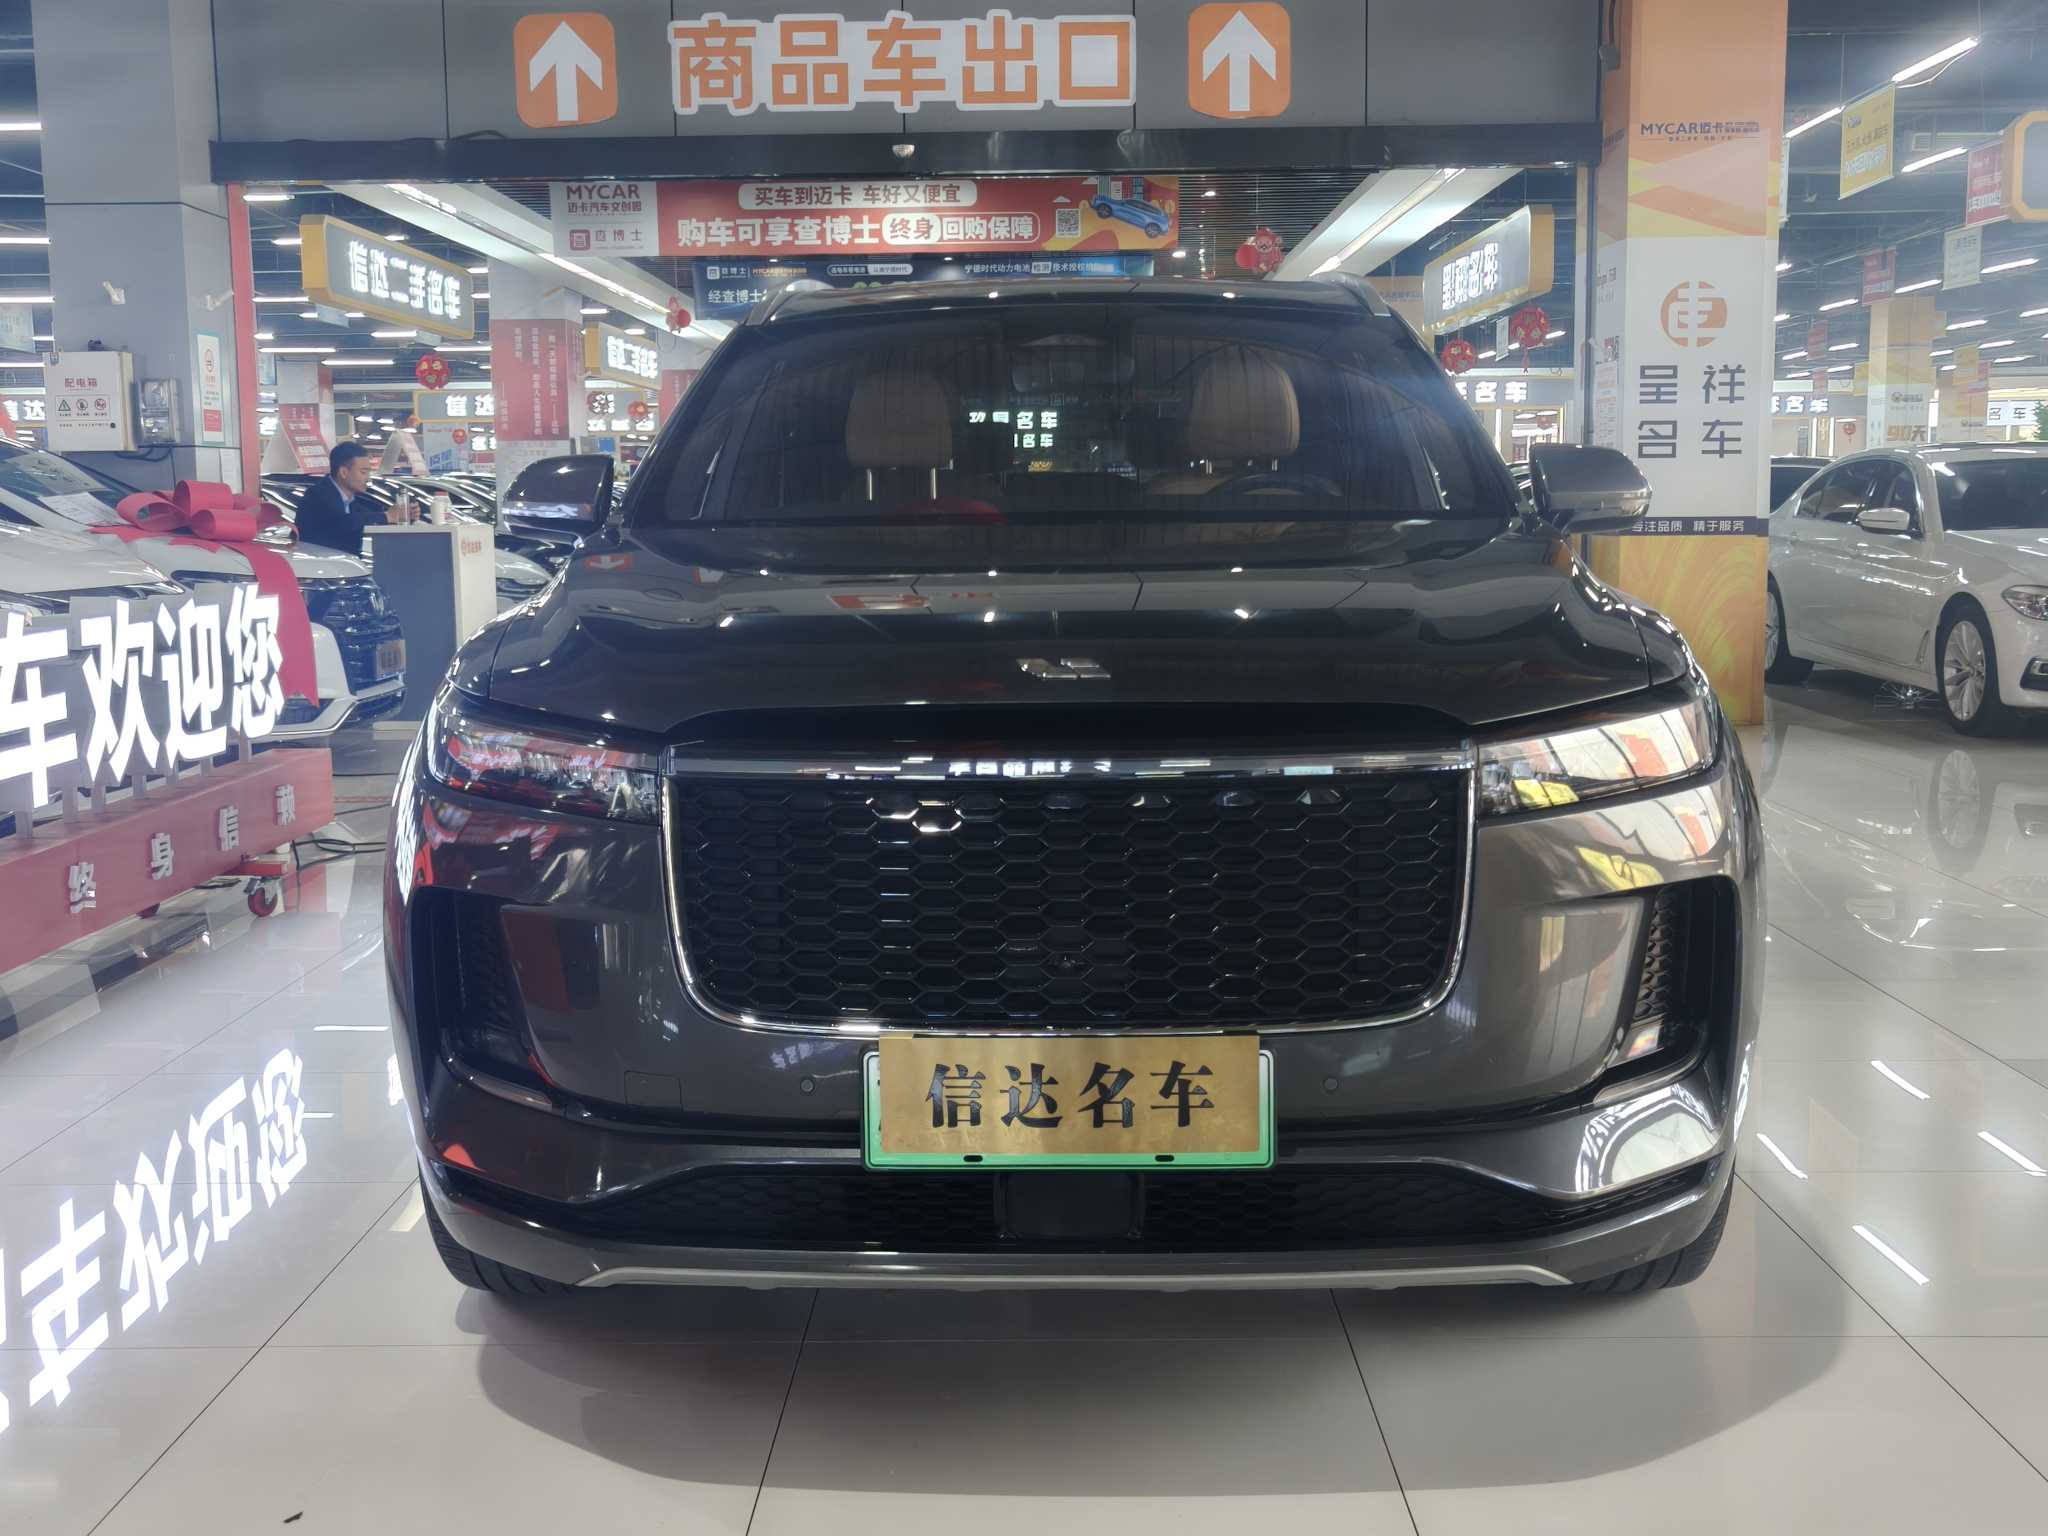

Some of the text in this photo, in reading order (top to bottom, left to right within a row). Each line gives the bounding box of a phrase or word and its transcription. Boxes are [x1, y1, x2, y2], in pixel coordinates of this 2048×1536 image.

[670, 14, 1133, 110] 商品车出口
[566, 184, 640, 200] MYCAR
[568, 202, 642, 214] 迈卡汽车文创园
[755, 183, 961, 206] 买车到迈卡 车好又便宜
[678, 212, 1035, 248] 购车可享查博士终身回购保障
[348, 240, 462, 320] 信达二手名车
[64, 377, 97, 388] 配电箱
[1640, 364, 1746, 405] 呈祥
[1638, 419, 1743, 459] 名车
[1693, 520, 1744, 532] 精于服务
[0, 583, 284, 808] 车欢迎您
[925, 1060, 1215, 1129] 信达名车
